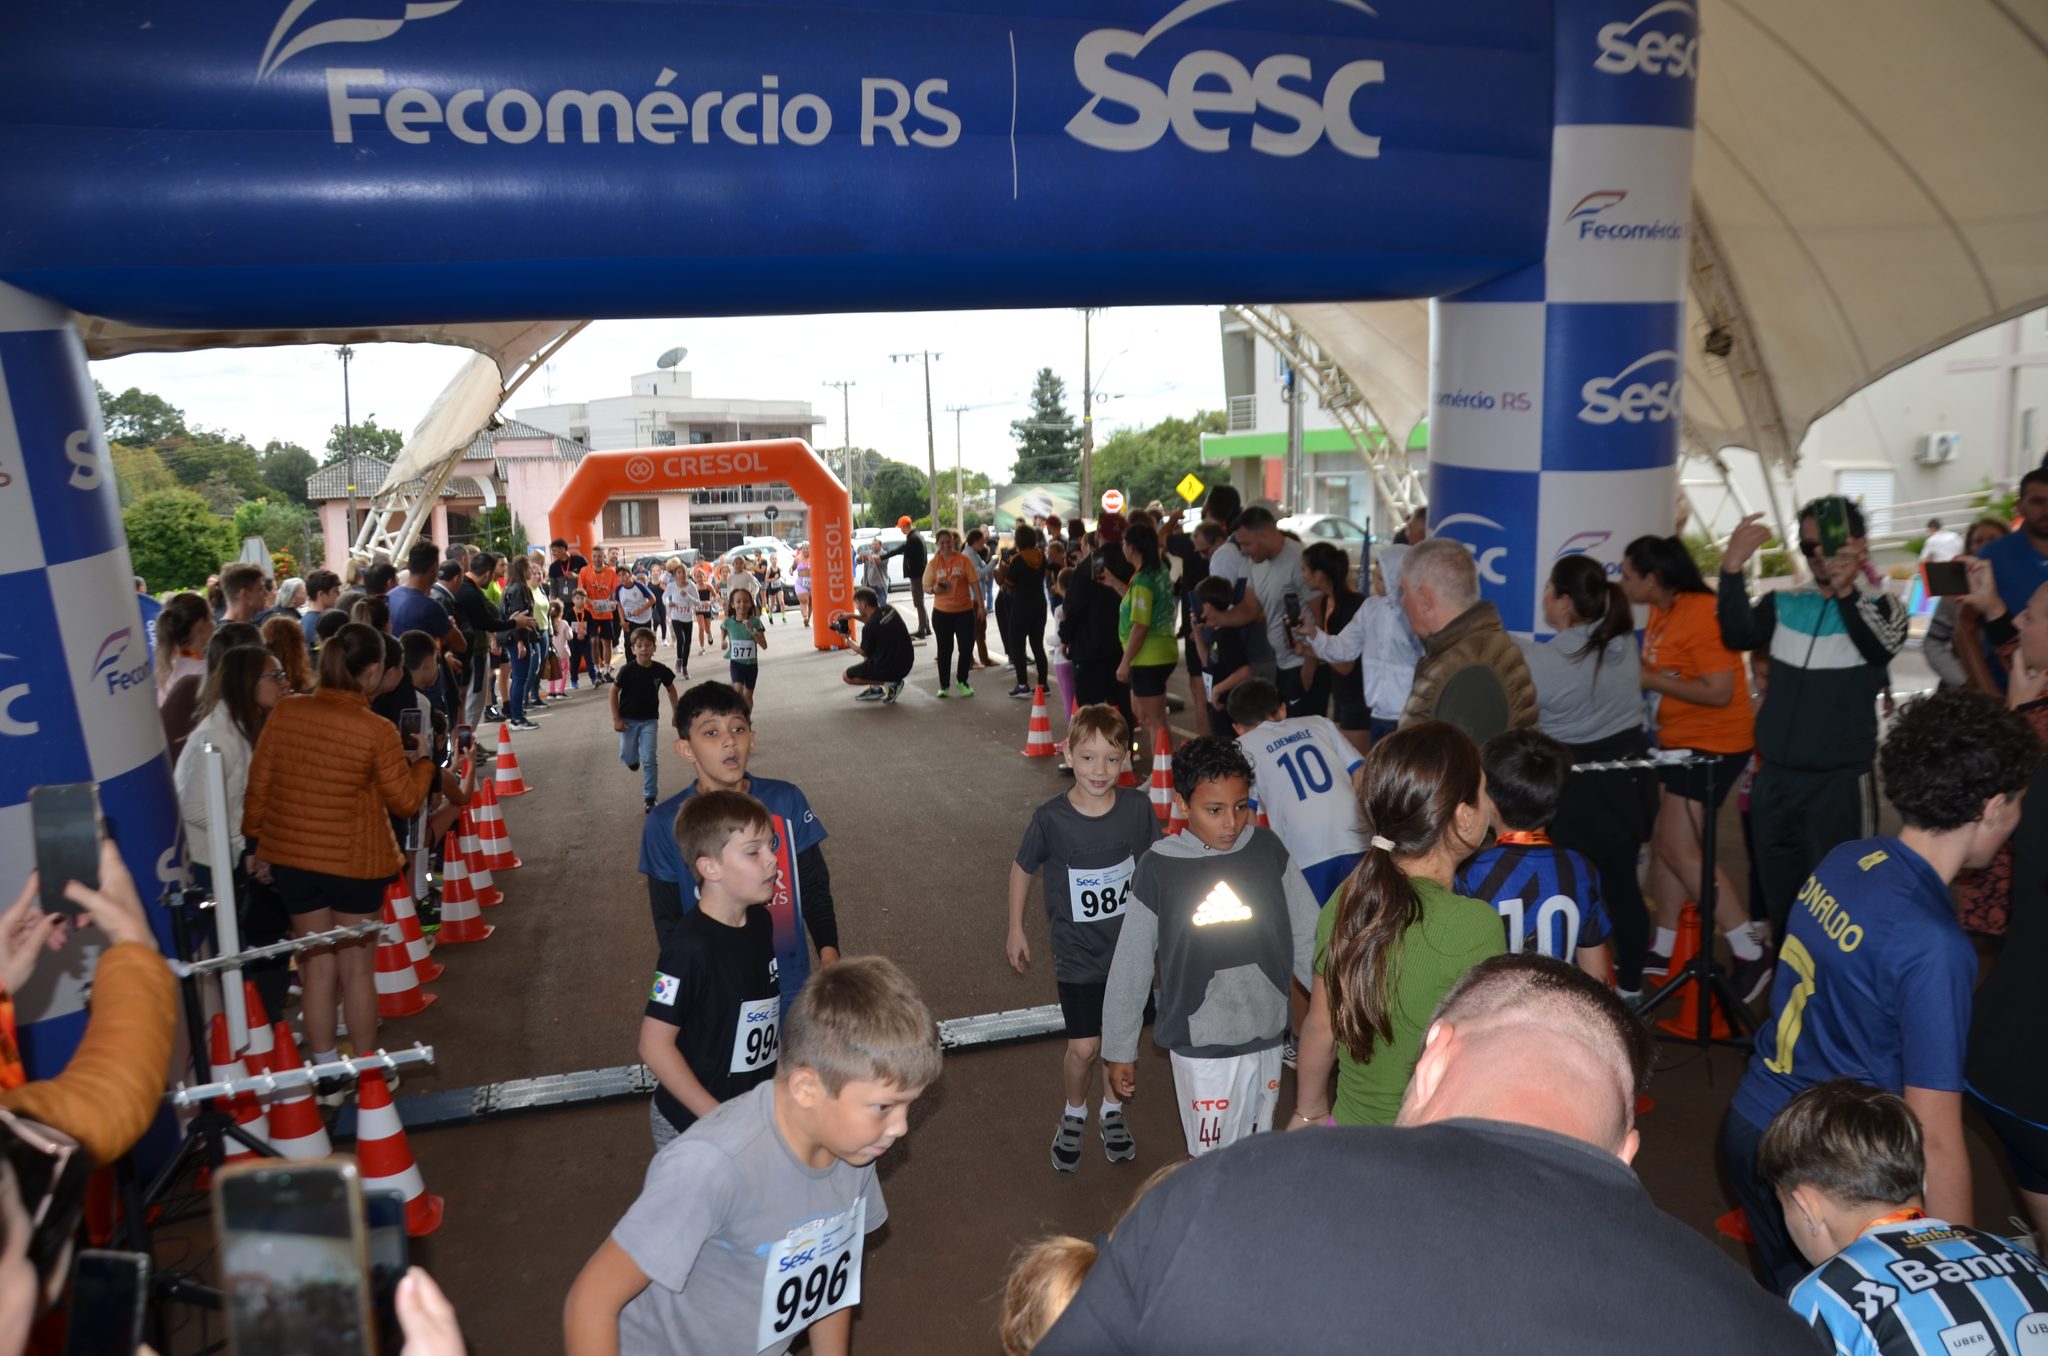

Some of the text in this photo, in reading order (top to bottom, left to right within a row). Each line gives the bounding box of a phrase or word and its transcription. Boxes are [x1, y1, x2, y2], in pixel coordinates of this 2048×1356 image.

[326, 67, 961, 148] Fecomércio RS
[1065, 27, 1386, 159] Sesc
[1502, 391, 1532, 411] RS
[663, 451, 769, 477] CRESOL
[825, 516, 846, 602] CRESOL
[733, 645, 753, 658] 977
[1276, 743, 1334, 802] 10
[1081, 879, 1130, 918] 984
[1498, 894, 1581, 966] 10
[1763, 933, 1816, 1075] 7
[1191, 1099, 1230, 1112] KTO
[1199, 1117, 1221, 1148] 44
[1901, 1226, 1966, 1245] umbro
[773, 1250, 852, 1333] 996
[1953, 1334, 1986, 1349] UBER
